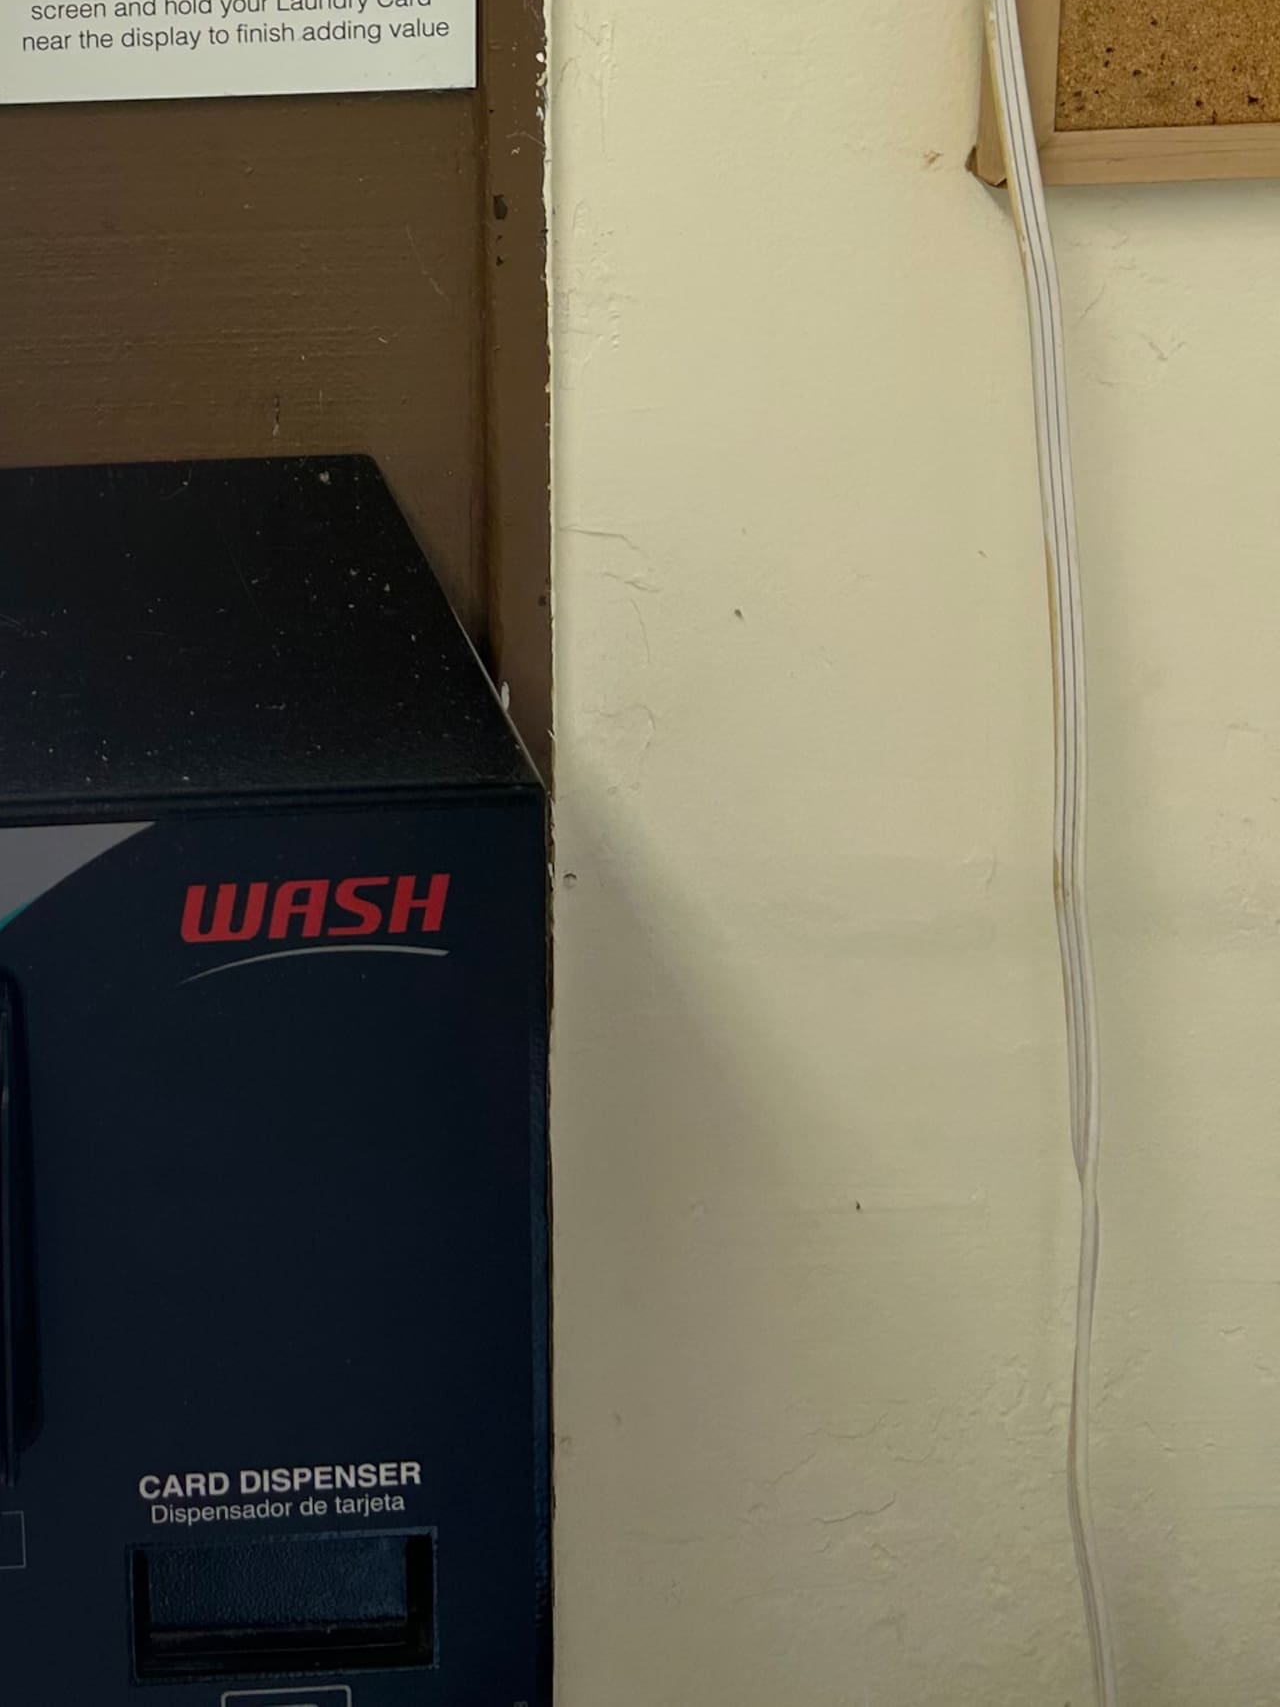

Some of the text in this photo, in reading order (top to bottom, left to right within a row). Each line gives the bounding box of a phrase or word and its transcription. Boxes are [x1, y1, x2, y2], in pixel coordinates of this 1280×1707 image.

[22, 17, 450, 52] near the display to finish adding value
[180, 873, 451, 943] WASH
[138, 1461, 422, 1501] CARD DISPENSER
[150, 1493, 405, 1527] Dispensador de tarjeta
